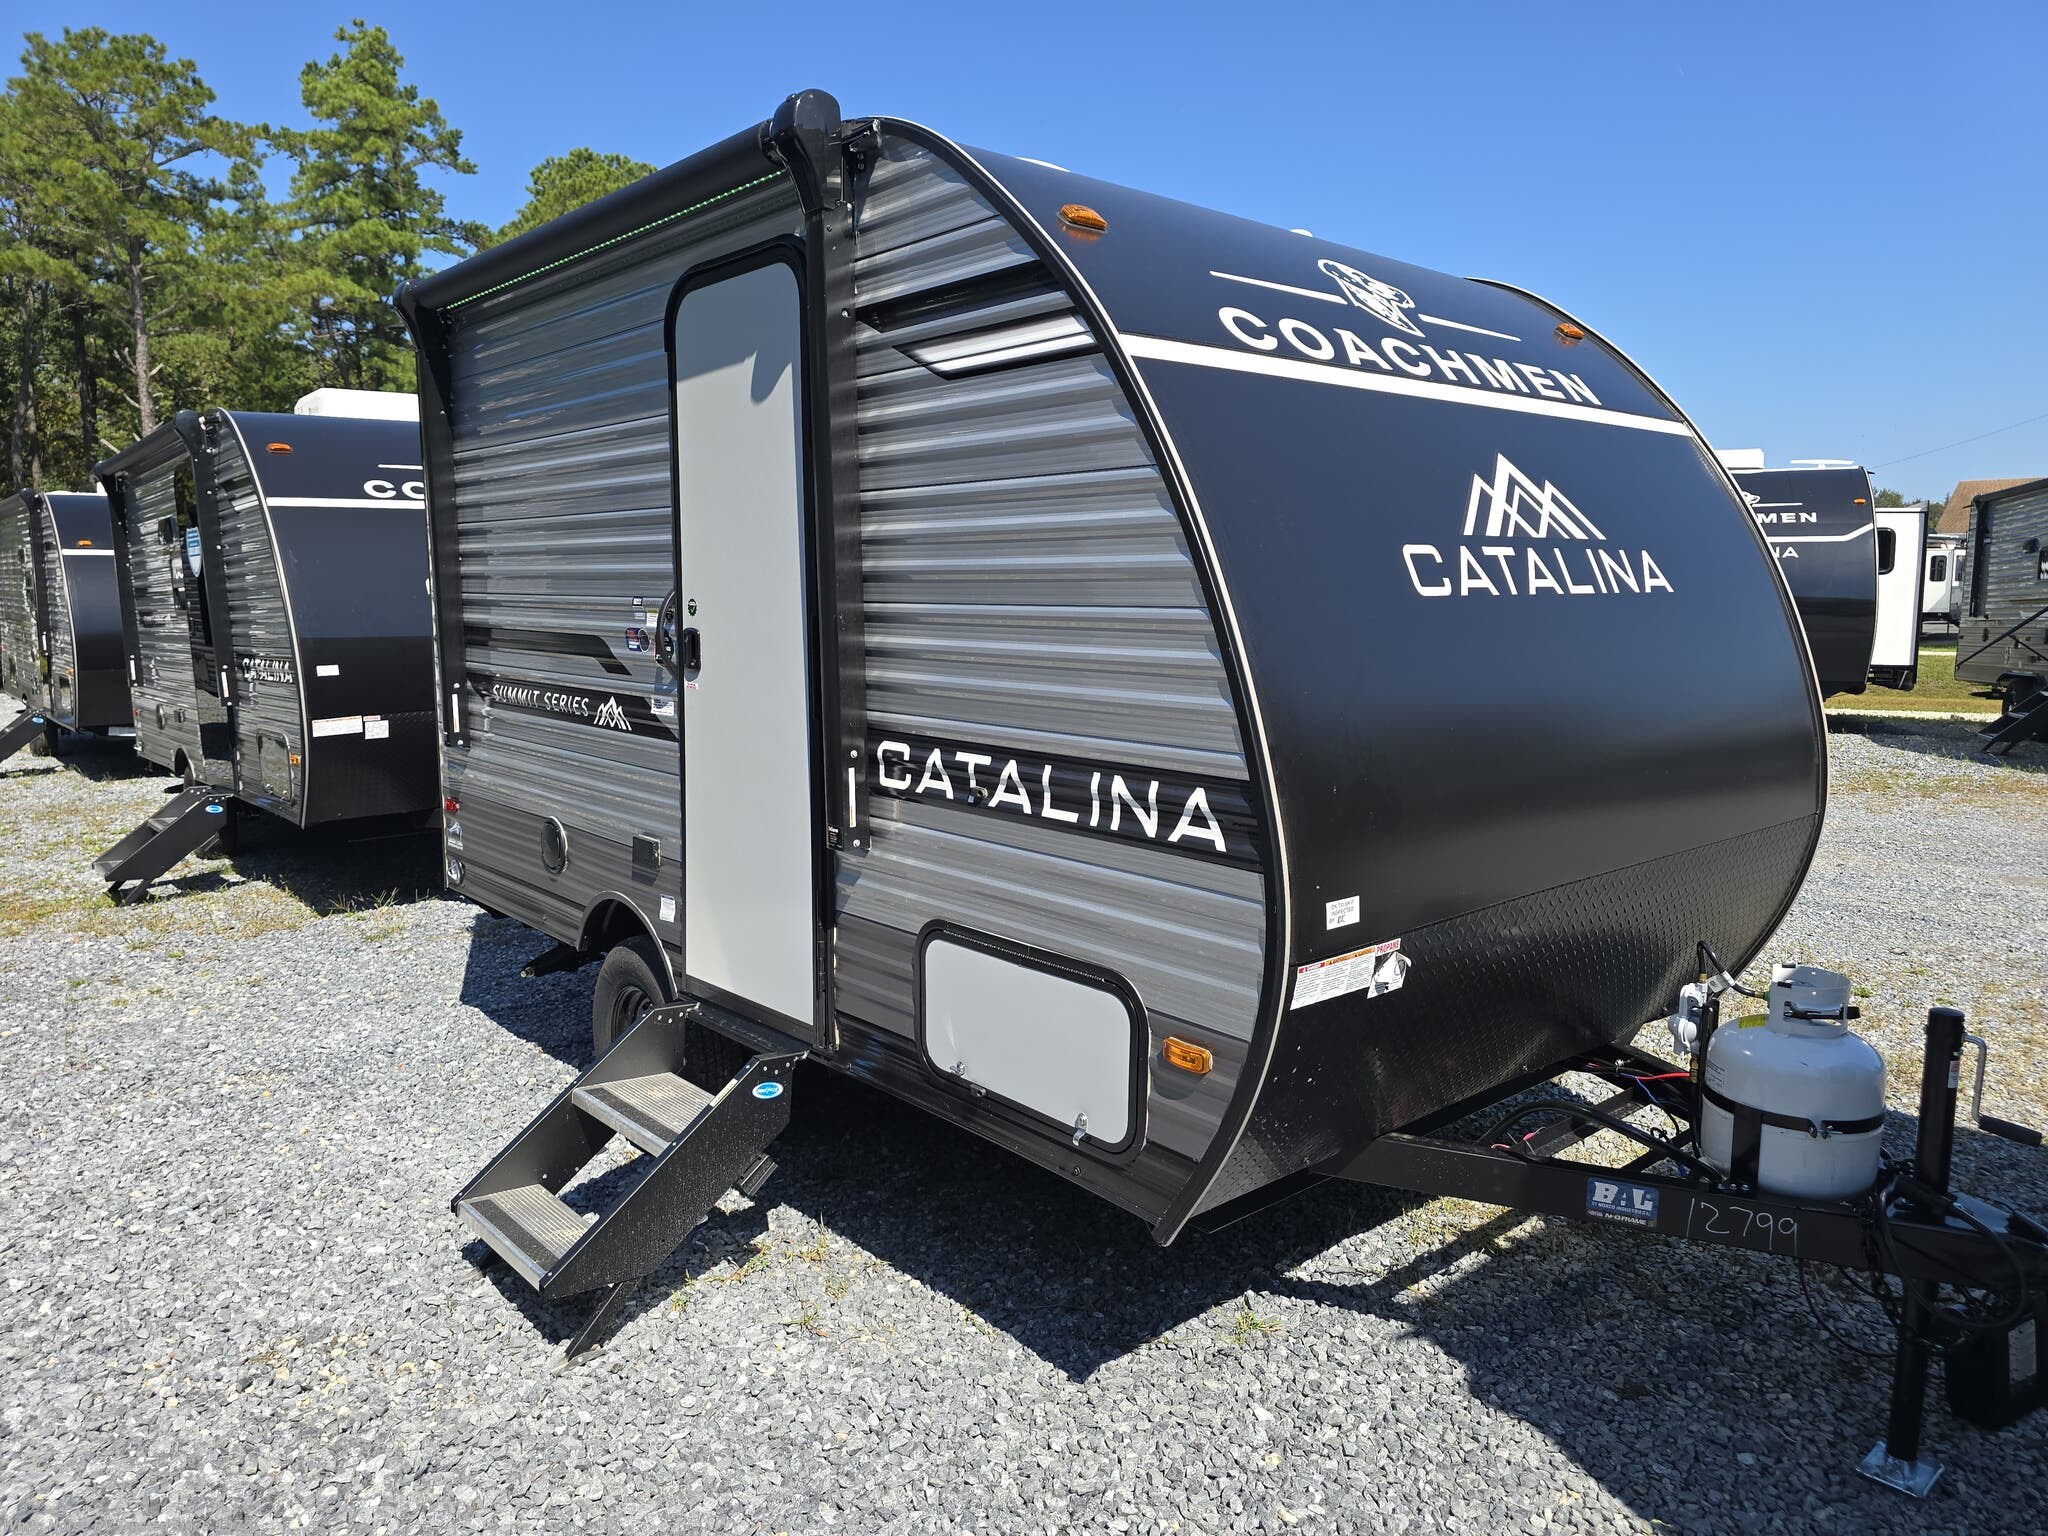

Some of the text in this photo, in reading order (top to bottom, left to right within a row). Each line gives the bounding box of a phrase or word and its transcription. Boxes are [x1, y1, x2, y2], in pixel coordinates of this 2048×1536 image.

[1218, 306, 1602, 406] COACHMEN
[1402, 543, 1675, 597] CATALINA
[492, 684, 589, 717] SUMMIT SERIES
[876, 740, 1227, 852] CATALINA
[1376, 940, 1400, 956] PROPANE
[1686, 1197, 1798, 1257] 12799
